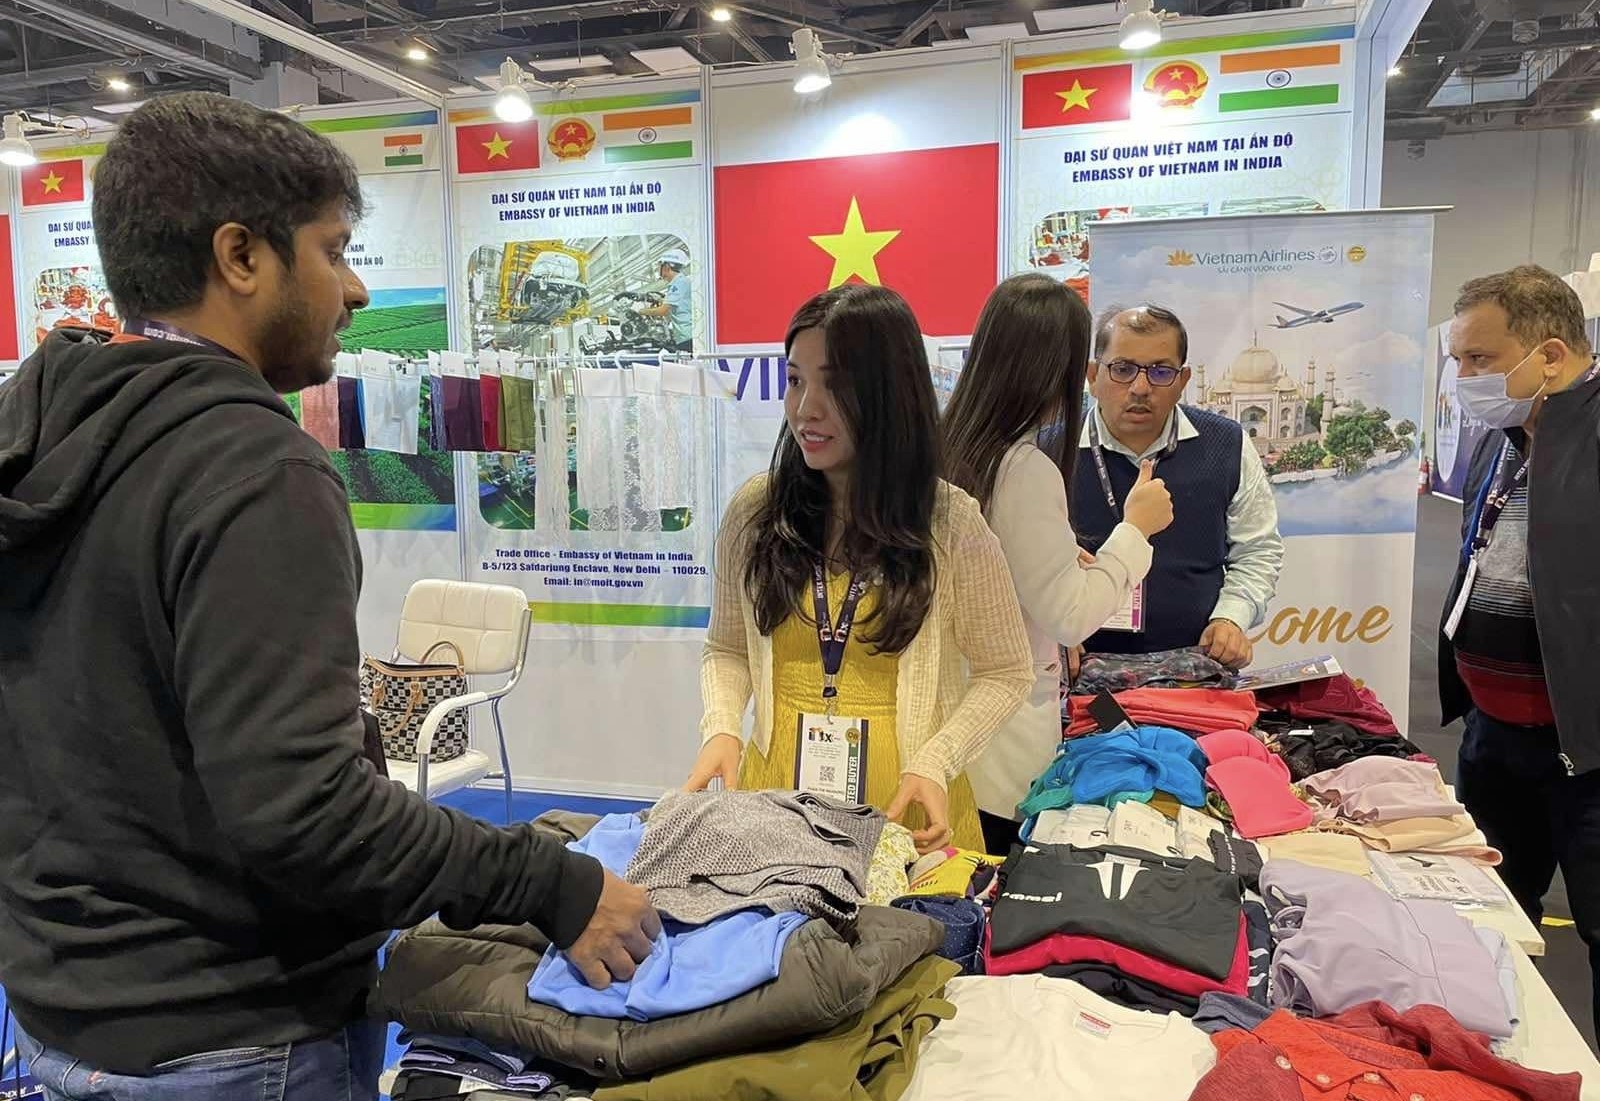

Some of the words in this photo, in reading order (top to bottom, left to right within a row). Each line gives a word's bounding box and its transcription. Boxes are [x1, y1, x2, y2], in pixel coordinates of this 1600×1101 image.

[1187, 139, 1218, 154] NAM
[1222, 137, 1245, 153] TẠI
[1072, 166, 1134, 183] EMBASSY
[1138, 165, 1155, 178] OF
[1159, 160, 1219, 176] VIETNAM
[1224, 158, 1238, 171] IN
[1243, 155, 1282, 170] INDIA
[583, 186, 607, 199] NAM
[499, 208, 546, 221] EMBASSY
[548, 207, 561, 218] OF
[564, 204, 609, 217] VIETNAM
[612, 203, 623, 214] IN
[626, 201, 656, 214] INDIA
[54, 236, 90, 248] EMBASSY
[1196, 251, 1259, 266] Vietnam
[1259, 249, 1315, 263] Airlines
[495, 548, 522, 558] Trade
[523, 549, 551, 558] Office
[559, 550, 600, 560] Embassy
[602, 551, 612, 560] of
[614, 551, 653, 561] Vietnam
[656, 551, 666, 561] in
[668, 552, 693, 562] India
[482, 562, 518, 571] B-5/123
[519, 562, 571, 573] Safdarjung
[613, 564, 633, 574] New
[636, 565, 661, 575] Delhi
[543, 576, 572, 586] Email:
[847, 756, 859, 784] BUYER
[846, 784, 858, 805] STED
